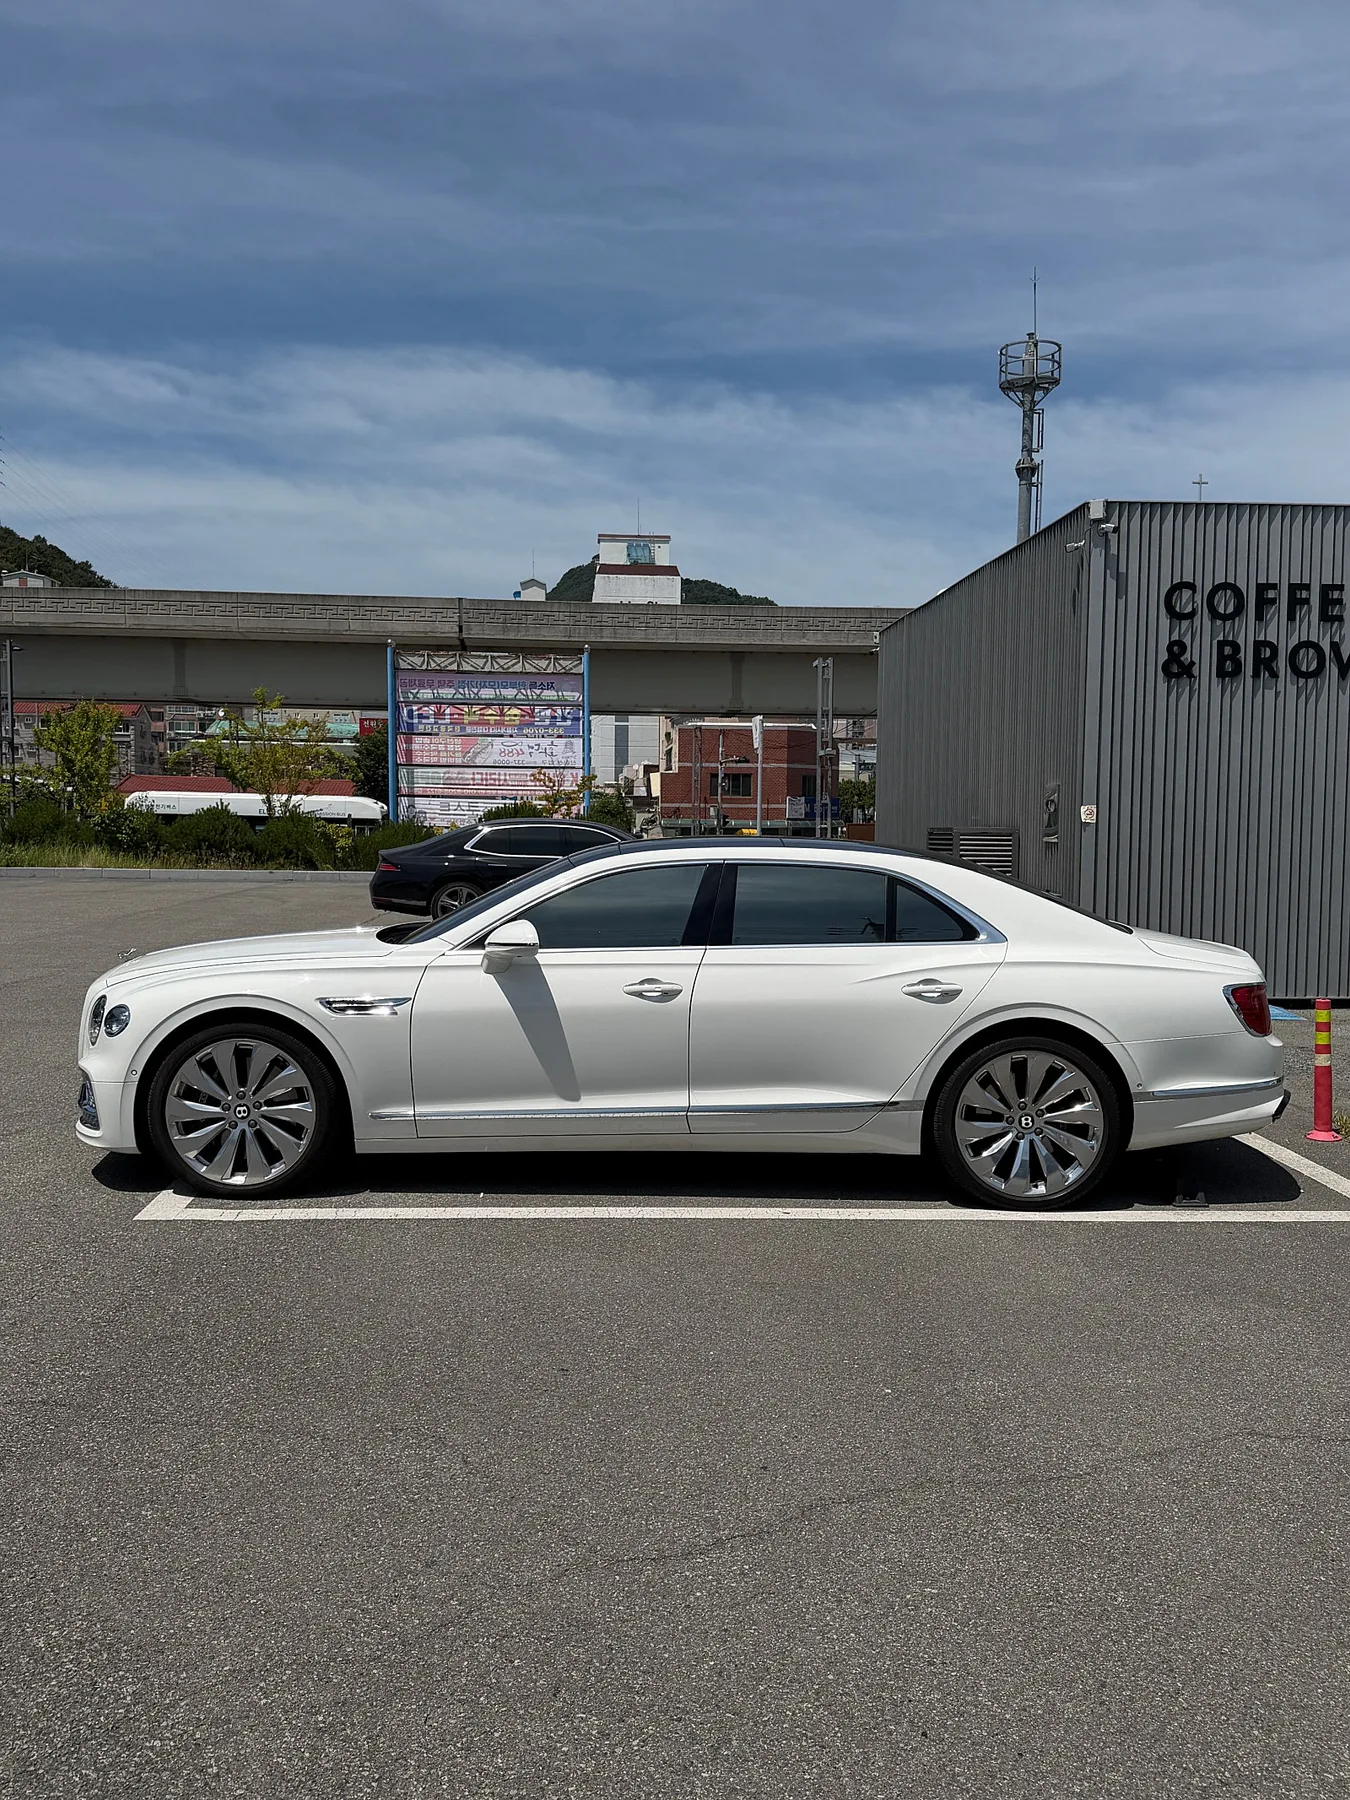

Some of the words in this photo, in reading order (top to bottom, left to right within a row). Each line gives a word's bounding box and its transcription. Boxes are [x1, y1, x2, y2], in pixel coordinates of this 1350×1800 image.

[1164, 581, 1345, 622] COFFE
[1161, 639, 1197, 678] &
[1021, 1116, 1033, 1128] B
